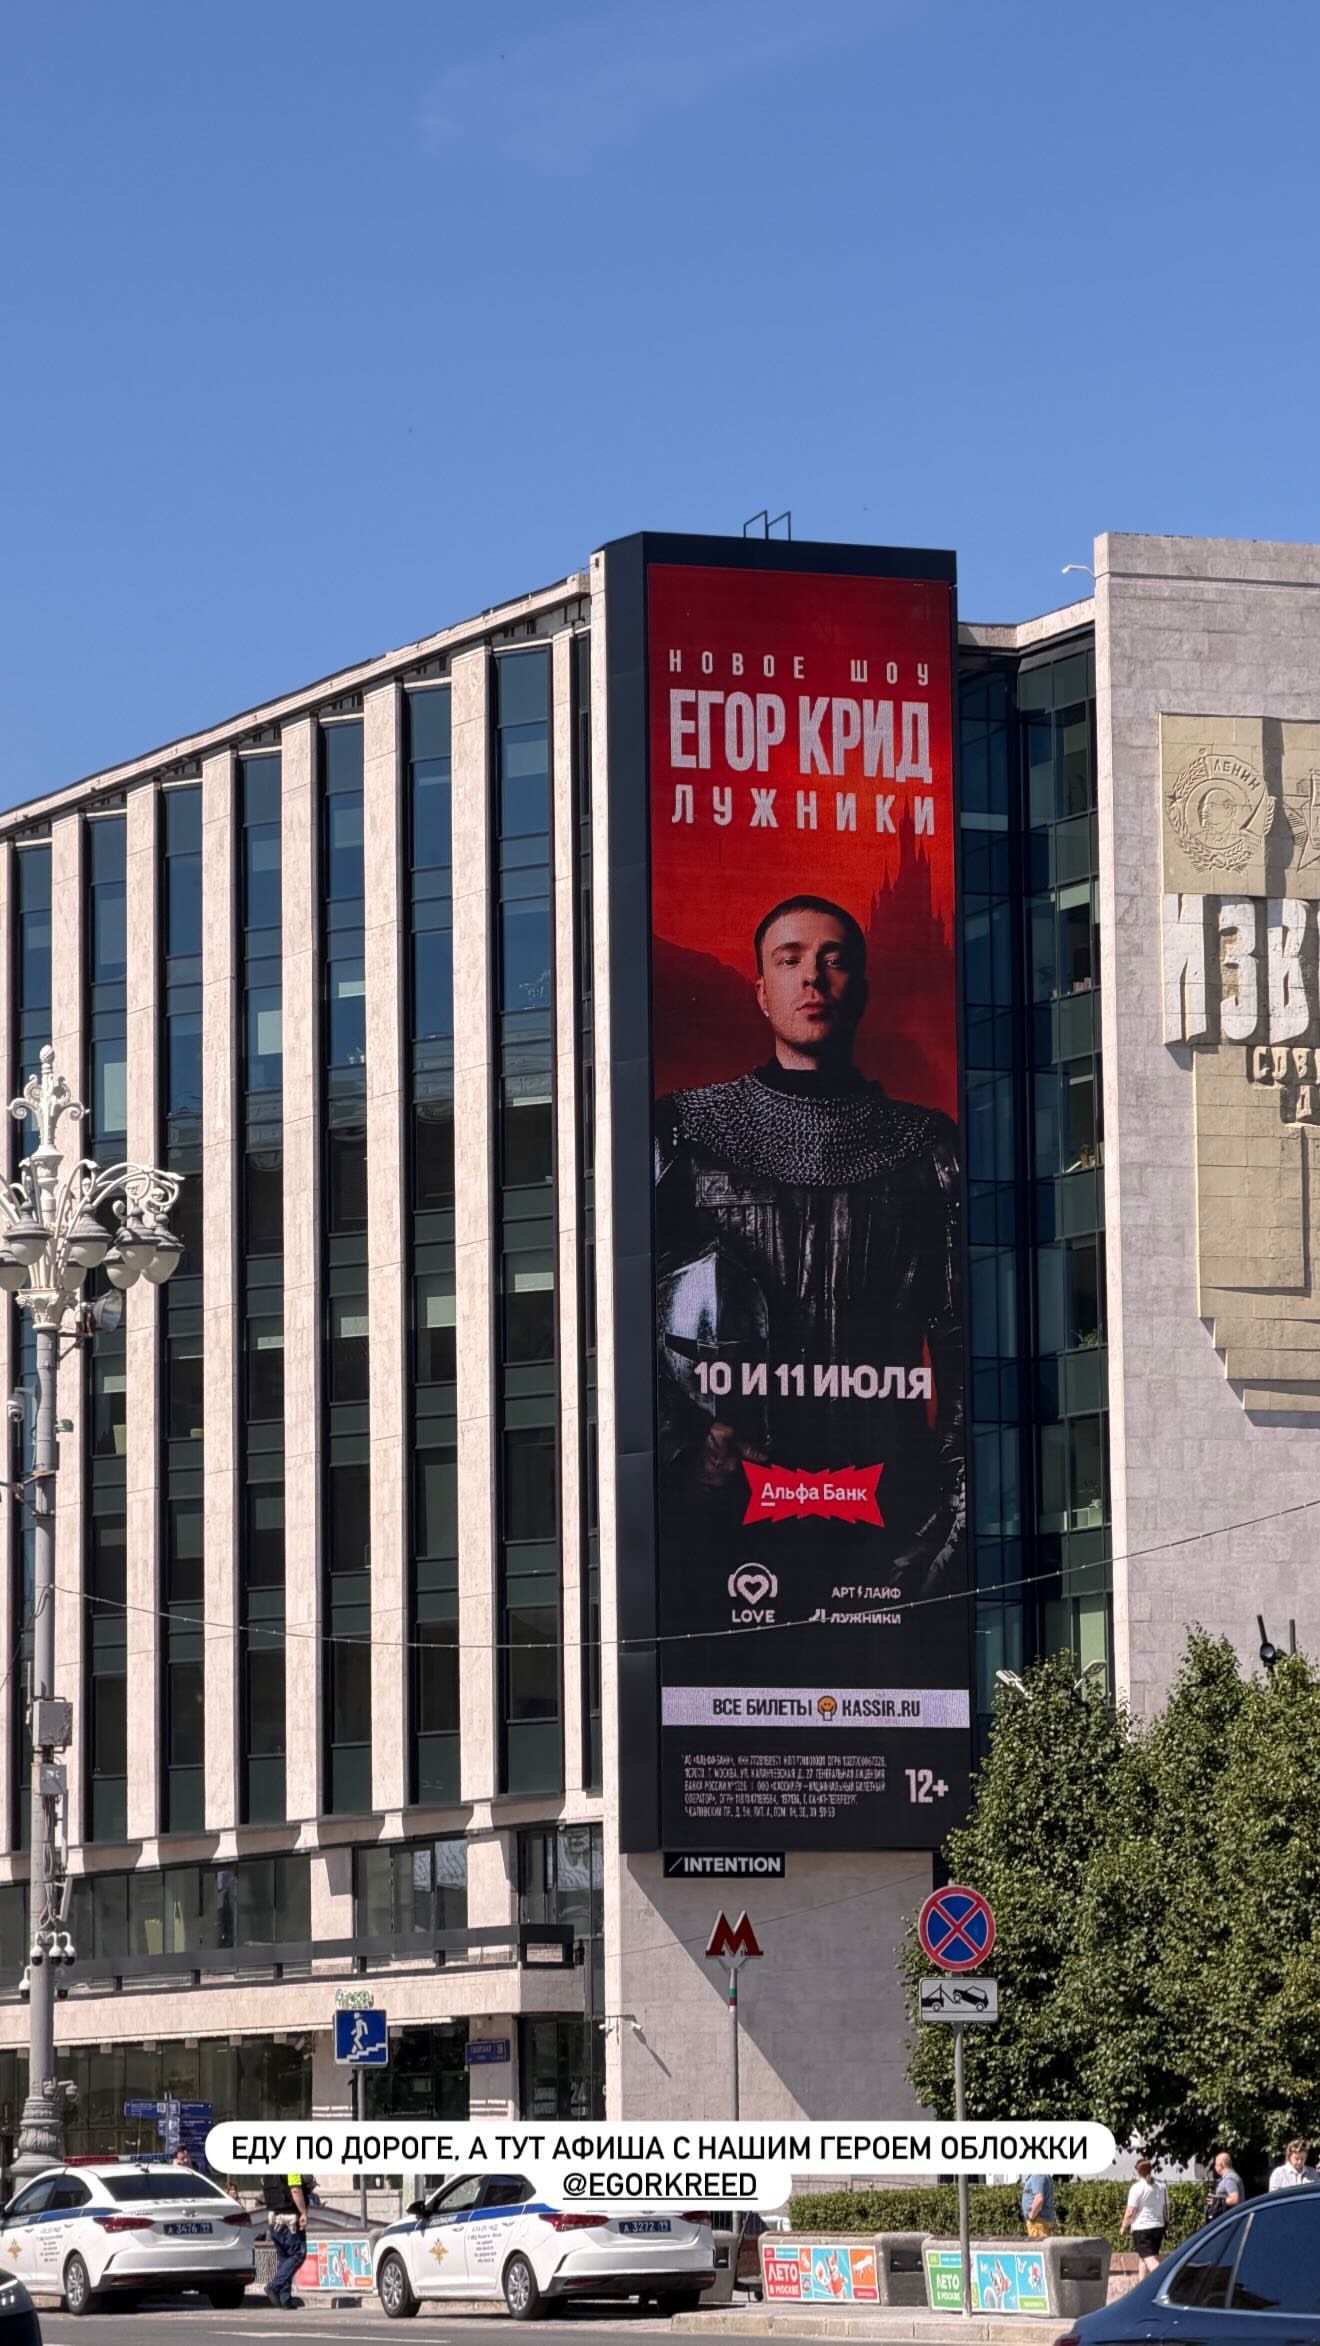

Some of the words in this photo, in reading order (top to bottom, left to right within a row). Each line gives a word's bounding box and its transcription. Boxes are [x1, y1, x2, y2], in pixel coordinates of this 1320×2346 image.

[669, 649, 805, 679] НОВОЕ
[851, 659, 929, 686] ШОУ
[669, 688, 786, 772] ЕГОР
[798, 695, 932, 784] КРИД
[1214, 759, 1261, 791] ЛЕНИН
[671, 784, 935, 836] ЛУЖНИКИ
[1161, 893, 1320, 1046] ИЗВ
[1253, 1046, 1320, 1085] СОВ
[694, 1361, 732, 1395] 10
[742, 1363, 767, 1396] И
[774, 1363, 802, 1396] 11
[814, 1364, 932, 1400] ИЮЛЯ
[760, 1482, 819, 1504] Альфа
[823, 1484, 868, 1502] Банк
[831, 1586, 855, 1599] АРТ
[863, 1585, 902, 1600] ЛАЙФ
[731, 1609, 776, 1624] LOVE
[829, 1612, 902, 1625] ЛУЖНИКИ
[713, 1698, 741, 1716] ВСЕ
[746, 1698, 813, 1717] БИЛЕТЫ
[842, 1699, 921, 1718] KASSIR.RU
[904, 1768, 949, 1804] 12+
[768, 2263, 798, 2283] ЛЕТО
[936, 2274, 960, 2290] ЛЕТО
